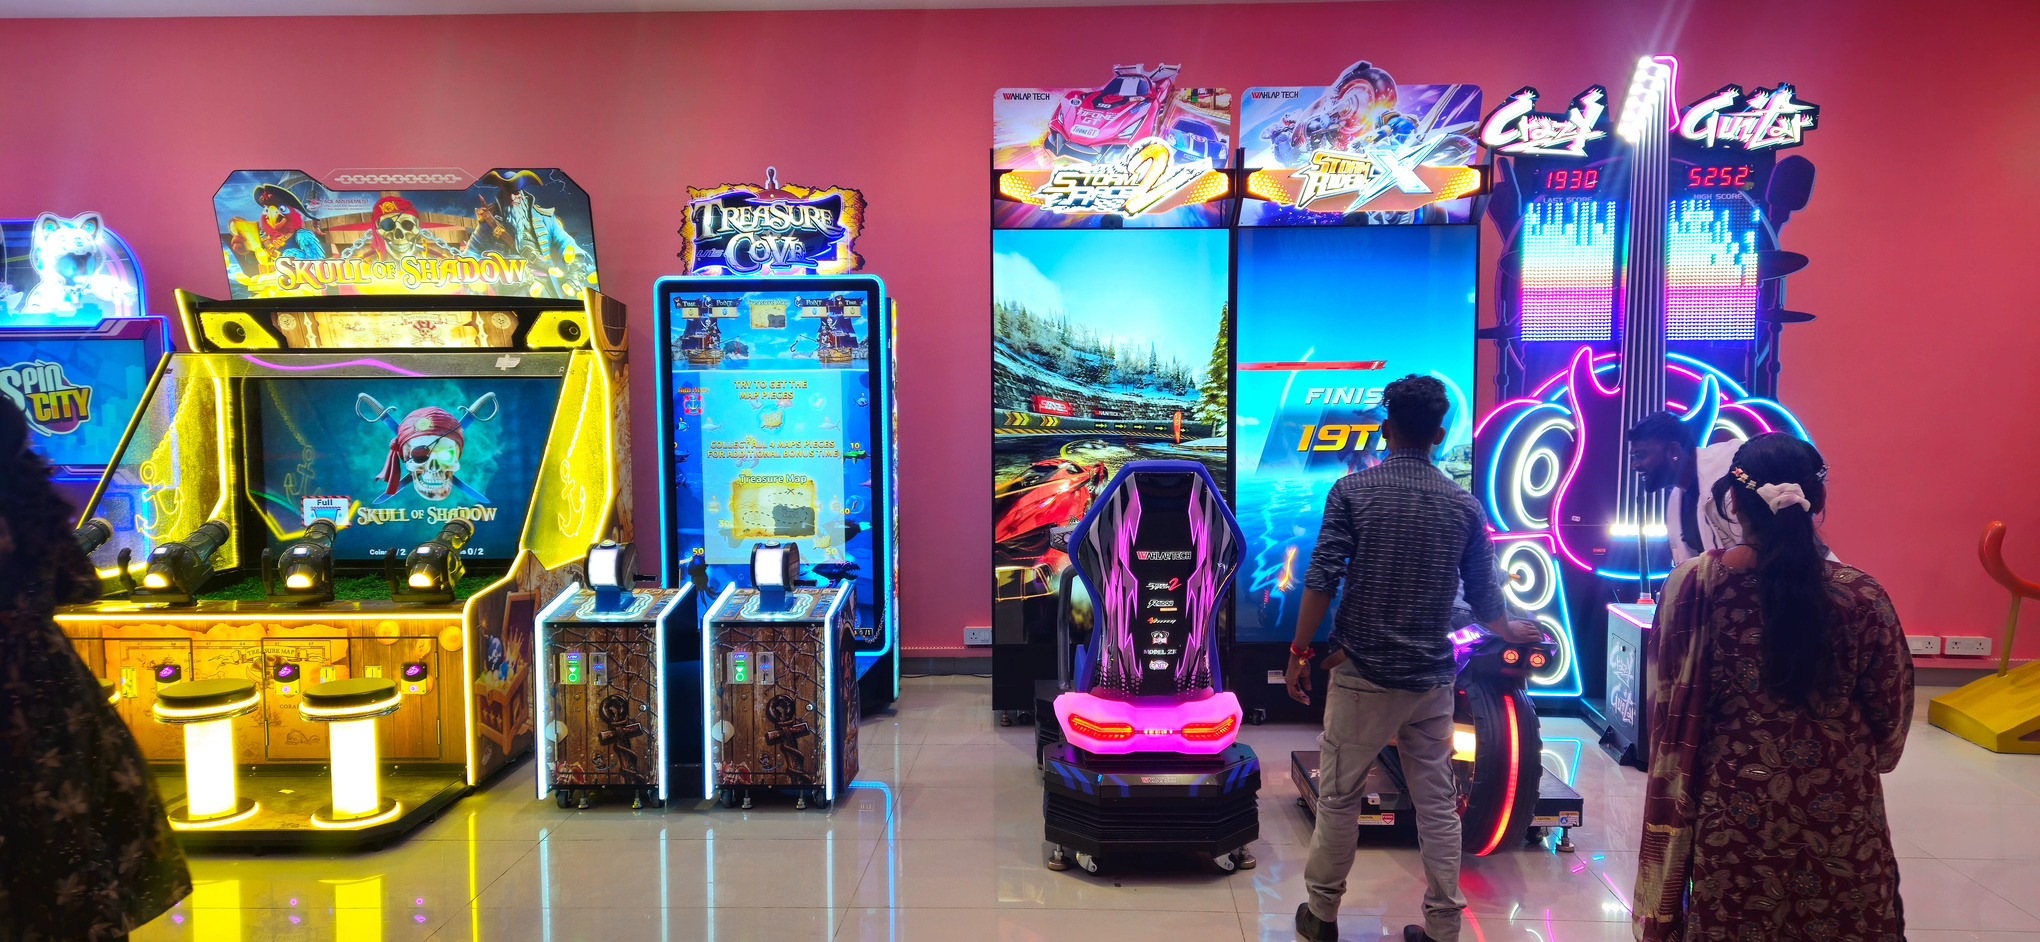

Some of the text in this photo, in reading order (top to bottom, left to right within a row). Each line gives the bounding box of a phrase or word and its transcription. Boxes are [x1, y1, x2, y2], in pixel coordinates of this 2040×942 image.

[1003, 92, 1050, 100] WAHLAP TECH
[1082, 116, 1101, 125] GT
[1312, 152, 1372, 179] STORM
[1546, 170, 1598, 189] 1930
[1688, 166, 1749, 187] 5252
[693, 201, 846, 242] TREASURE
[725, 232, 819, 275] COVE
[274, 251, 528, 291] SKULL OF SHADOW
[734, 380, 808, 389] TRY TO GET THE
[739, 391, 794, 400] MAP PIECES
[1304, 386, 1385, 406] FINIS
[26, 388, 89, 422] CITY
[710, 440, 751, 450] COLLECT
[777, 440, 801, 448] MAPS
[804, 440, 835, 448] PIECES
[707, 450, 838, 459] FOR ADDITIONAL BONUS TIME
[739, 474, 807, 485] Treasure Map
[356, 504, 498, 525] SKULL OF SHADOW
[718, 520, 731, 528] 30
[692, 548, 704, 556] 50
[826, 548, 838, 556] 50
[1136, 551, 1192, 560] WAHLAP TECH
